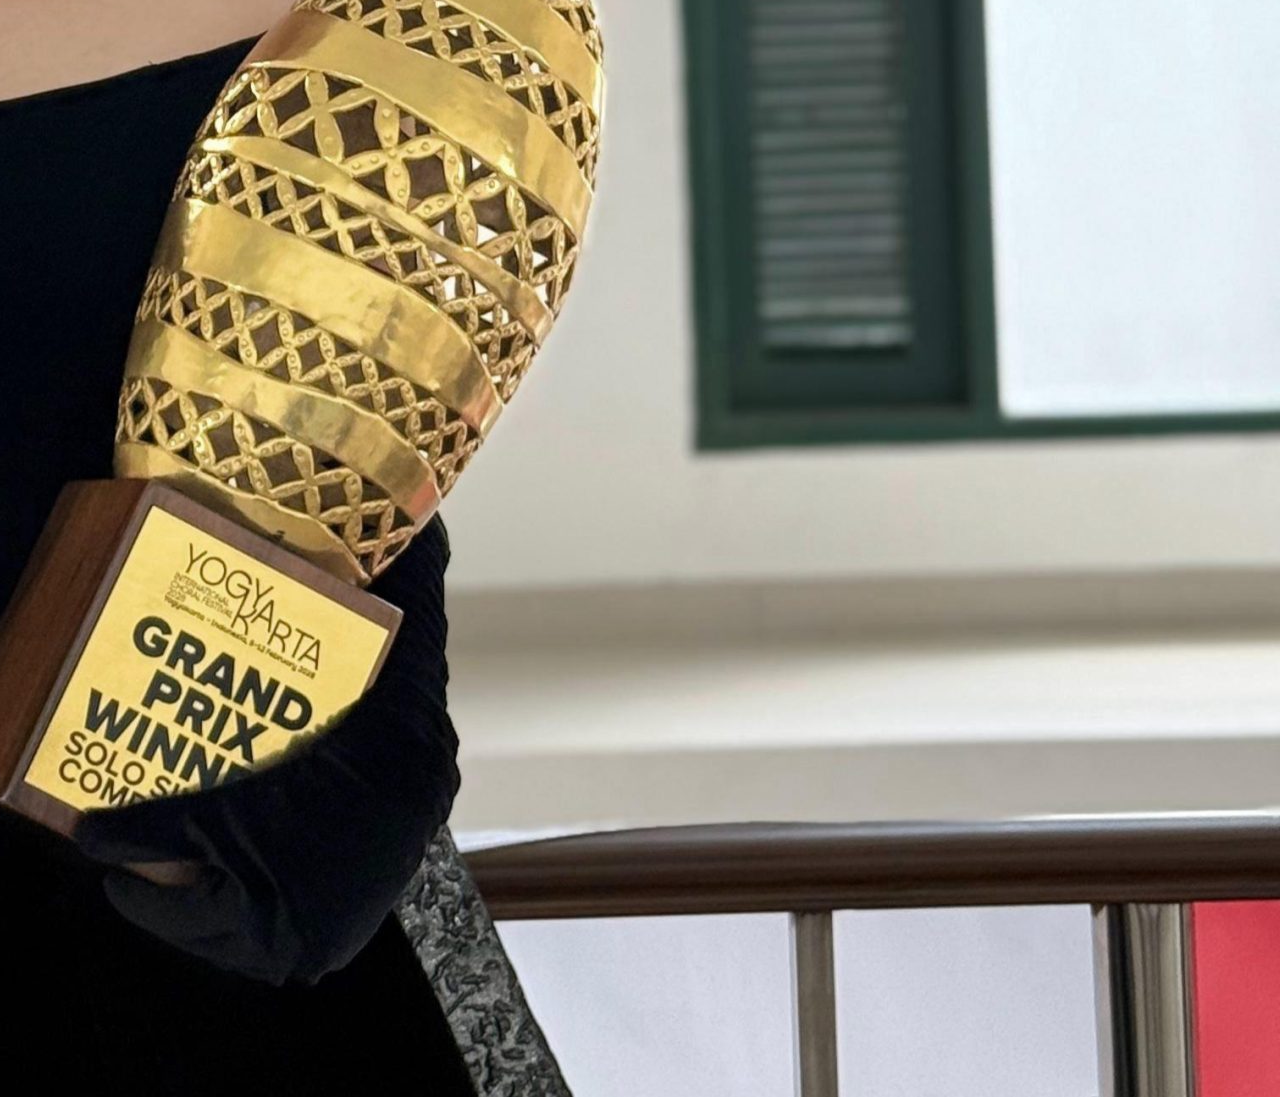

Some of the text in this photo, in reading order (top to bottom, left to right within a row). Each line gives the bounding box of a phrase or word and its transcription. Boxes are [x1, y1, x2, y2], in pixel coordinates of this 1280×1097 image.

[169, 579, 232, 618] CHORAL FESTIVAL
[173, 572, 228, 606] INTERNATIONAL
[132, 616, 312, 731] GRAND
[142, 670, 268, 764] PRIX
[64, 730, 145, 785] SOLO
